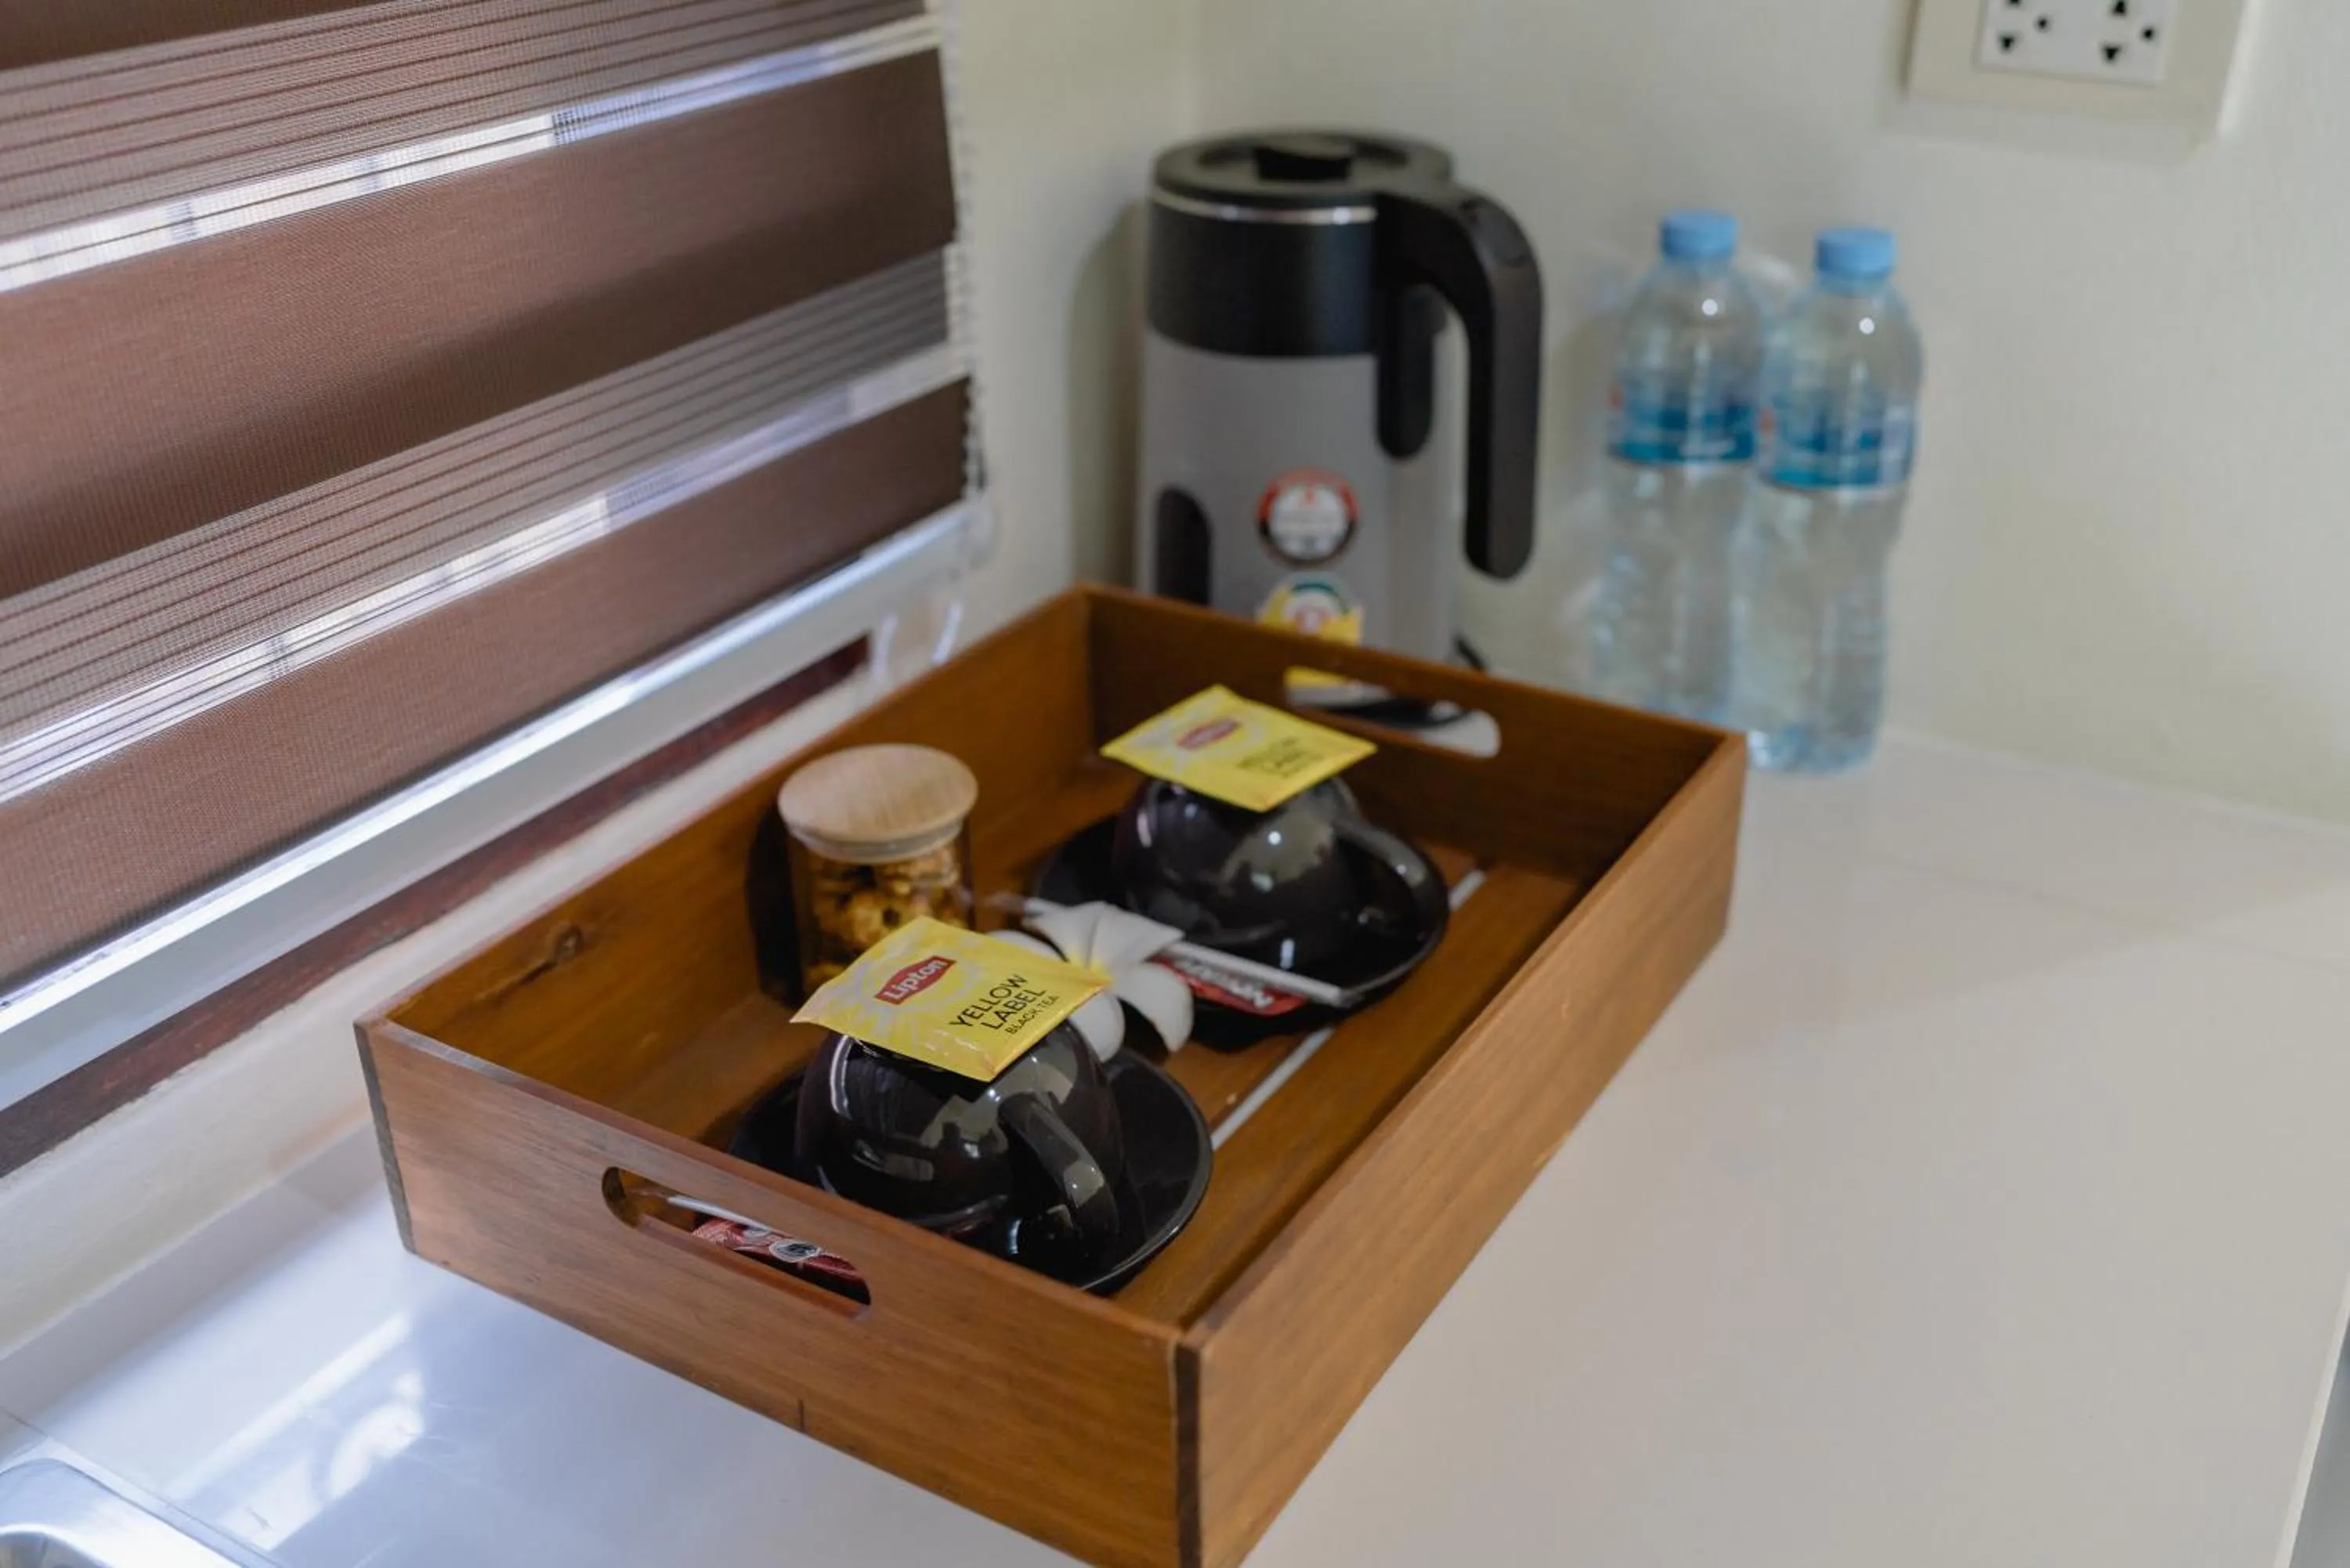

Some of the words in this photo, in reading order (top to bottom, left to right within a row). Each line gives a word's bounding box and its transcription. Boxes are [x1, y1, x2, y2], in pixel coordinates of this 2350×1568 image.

[883, 959, 948, 1000] Lipton
[949, 974, 1028, 1027] YELLOW
[980, 989, 1047, 1030] LABEL
[1004, 1008, 1043, 1035] BLACK
[1036, 995, 1060, 1010] TEA
